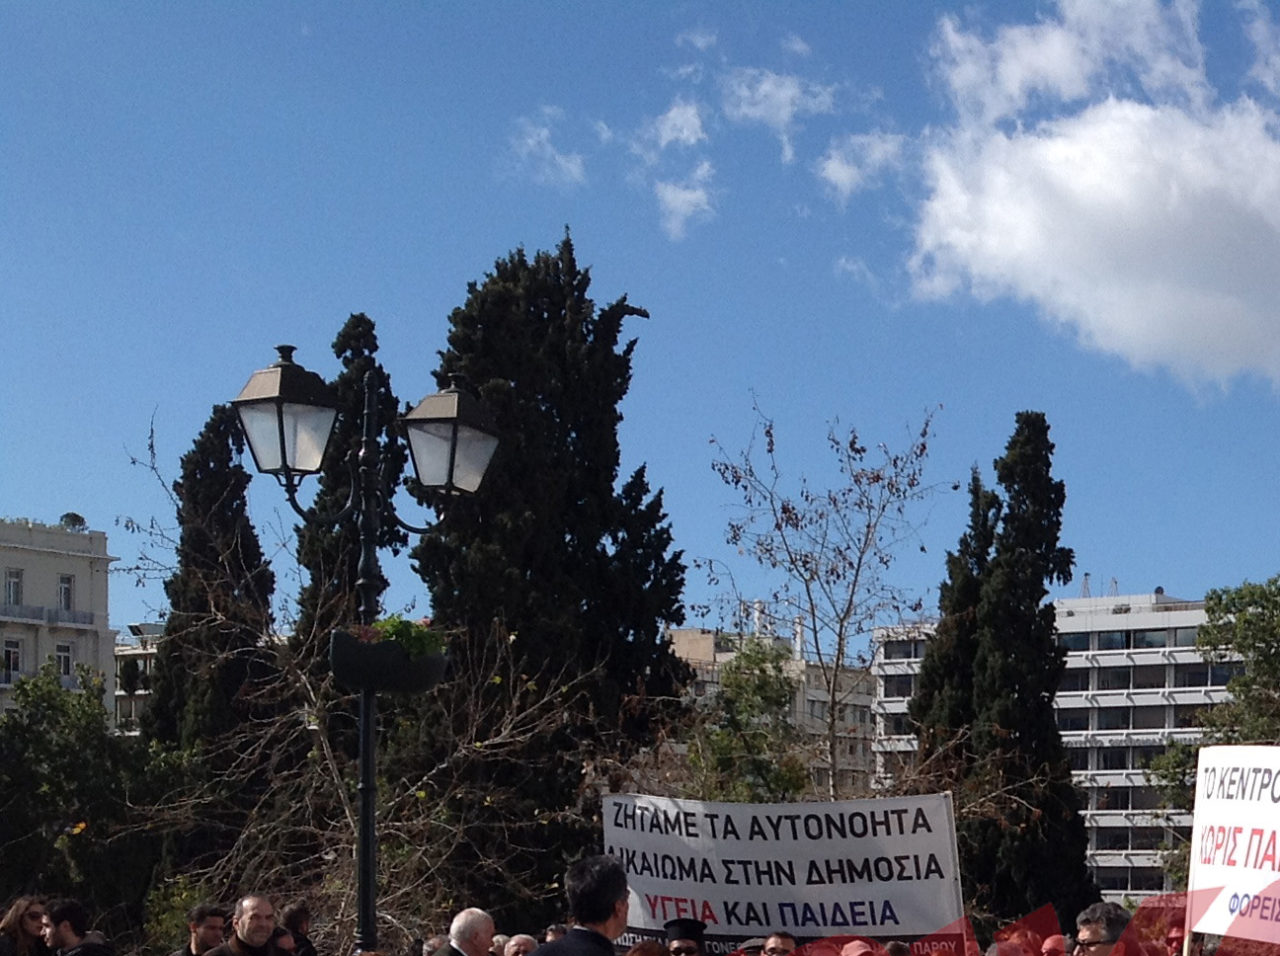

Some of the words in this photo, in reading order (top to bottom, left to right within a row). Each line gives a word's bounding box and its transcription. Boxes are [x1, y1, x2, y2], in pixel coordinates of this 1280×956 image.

[613, 801, 699, 838] ΖΗΤΑΜΕ
[704, 813, 741, 841] ΤΑ
[748, 807, 933, 841] ΑΥΤΟΝΟΗΤΑ
[721, 858, 796, 886] ΣΤΗΝ
[805, 853, 945, 886] ΔΗΜΟΣΙΑ
[645, 893, 719, 925] ΥΓΕΙΑ
[723, 900, 771, 927] ΚΑΙ
[778, 899, 900, 927] ΠΑΙΔΕΙΑ
